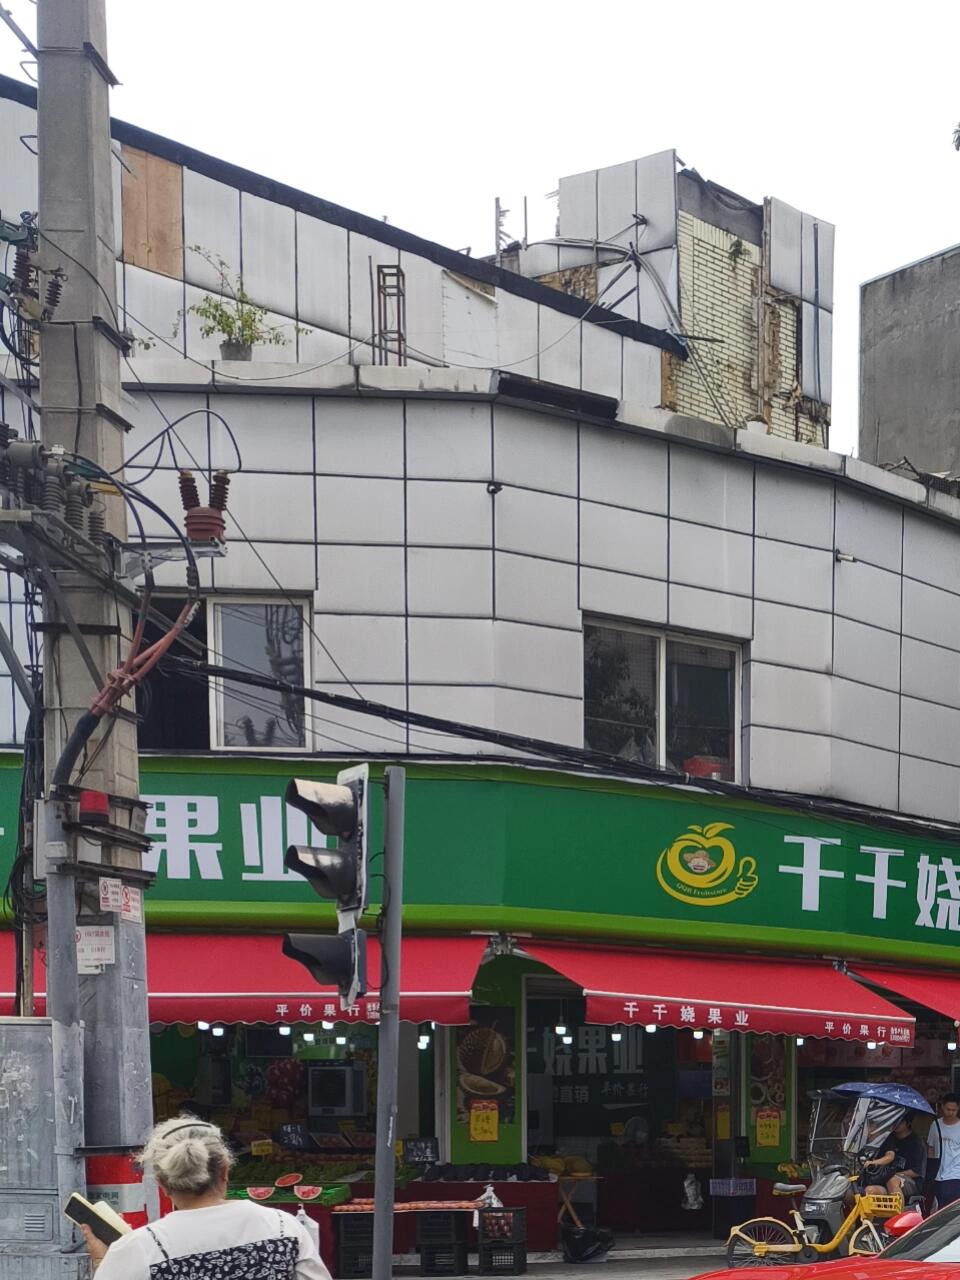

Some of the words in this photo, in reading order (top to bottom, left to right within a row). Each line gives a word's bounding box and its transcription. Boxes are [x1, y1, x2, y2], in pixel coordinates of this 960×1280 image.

[143, 795, 328, 881] 果业
[623, 1002, 749, 1026] 千千娆果业
